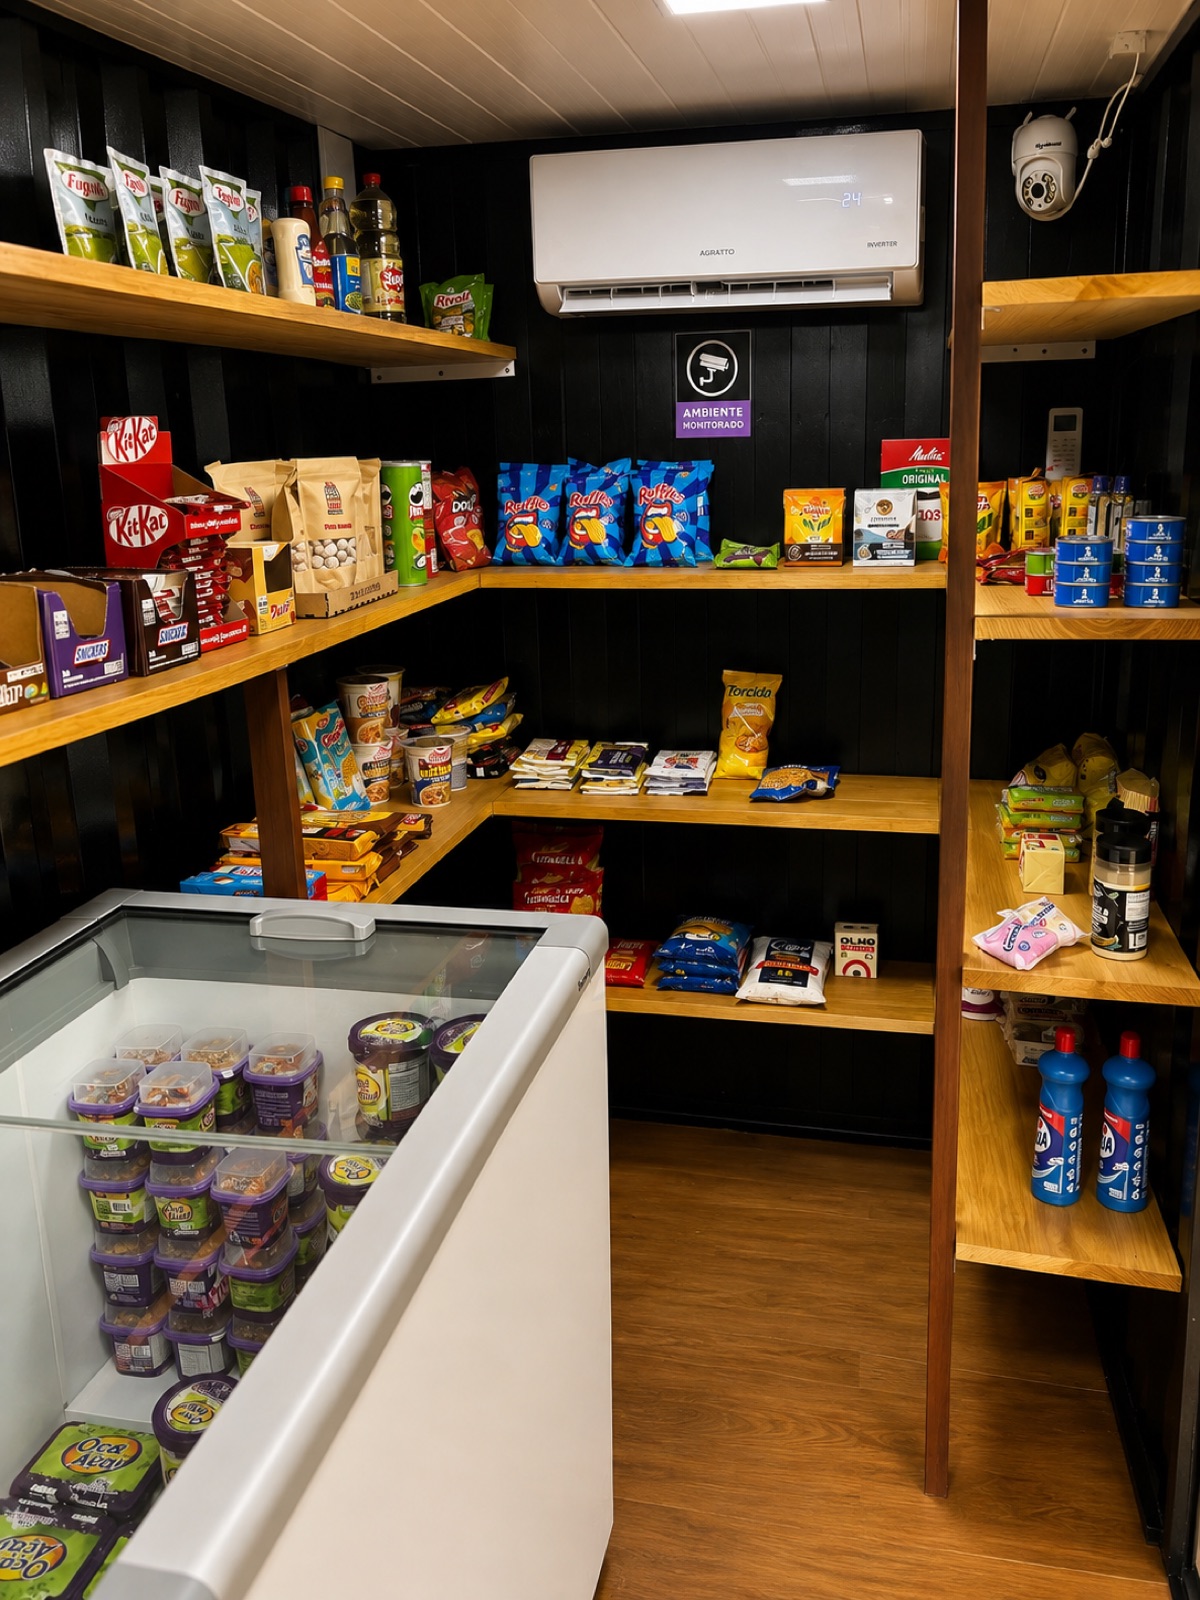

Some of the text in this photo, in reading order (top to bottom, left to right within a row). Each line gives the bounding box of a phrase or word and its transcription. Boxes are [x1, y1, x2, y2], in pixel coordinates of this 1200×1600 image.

[842, 192, 861, 208] 24
[683, 407, 743, 418] AMBIENTE
[683, 420, 744, 430] MONITORADO
[111, 416, 156, 462] KitKat
[902, 474, 946, 484] ORIGINAL
[115, 505, 166, 547] KitKat
[728, 685, 772, 698] Torcida
